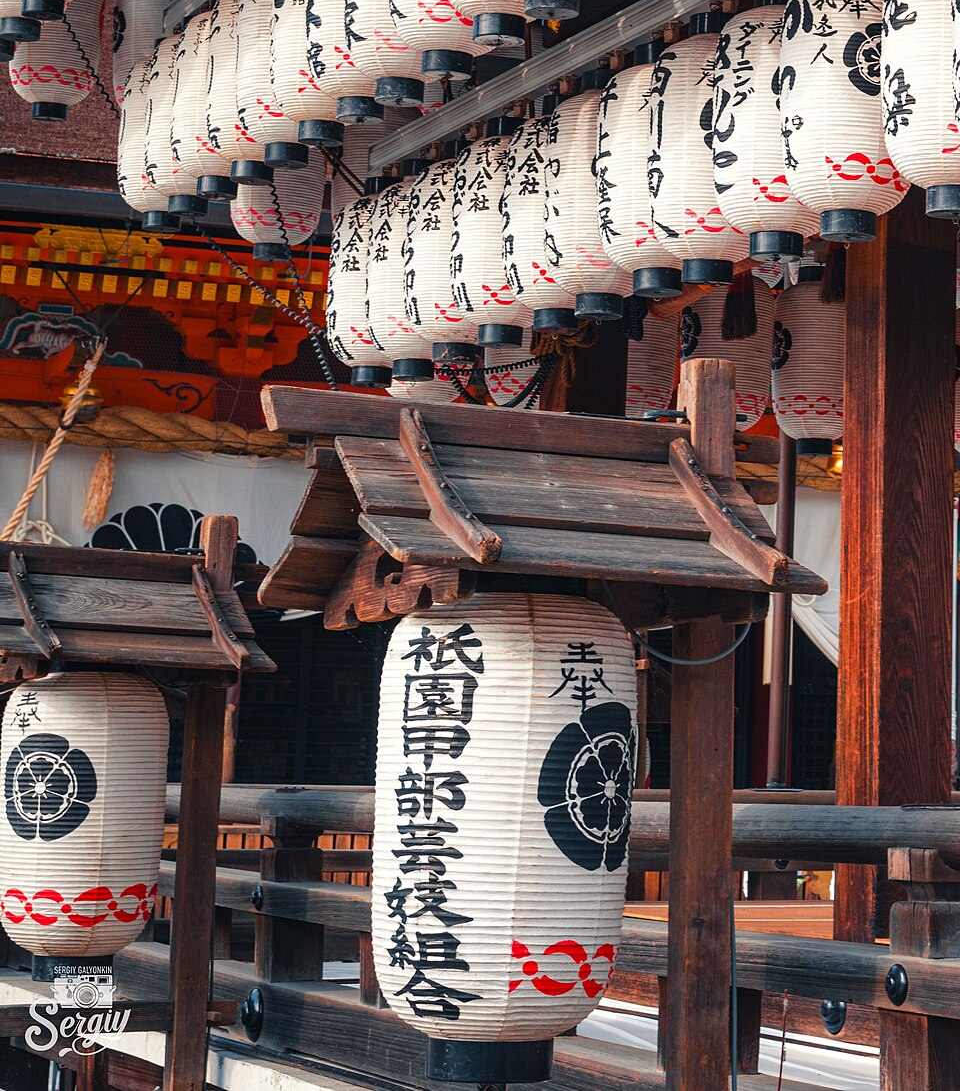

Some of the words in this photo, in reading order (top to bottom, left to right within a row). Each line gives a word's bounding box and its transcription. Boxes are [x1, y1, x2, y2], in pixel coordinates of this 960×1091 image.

[733, 21, 764, 107] ダイニング
[468, 138, 502, 212] 株式会社
[518, 115, 551, 195] 株式会社
[341, 197, 371, 273] 株式会社
[373, 184, 402, 262] 株式会社
[421, 162, 455, 232] 株式会社
[384, 623, 485, 1020] 祇園甲部芸妓組合
